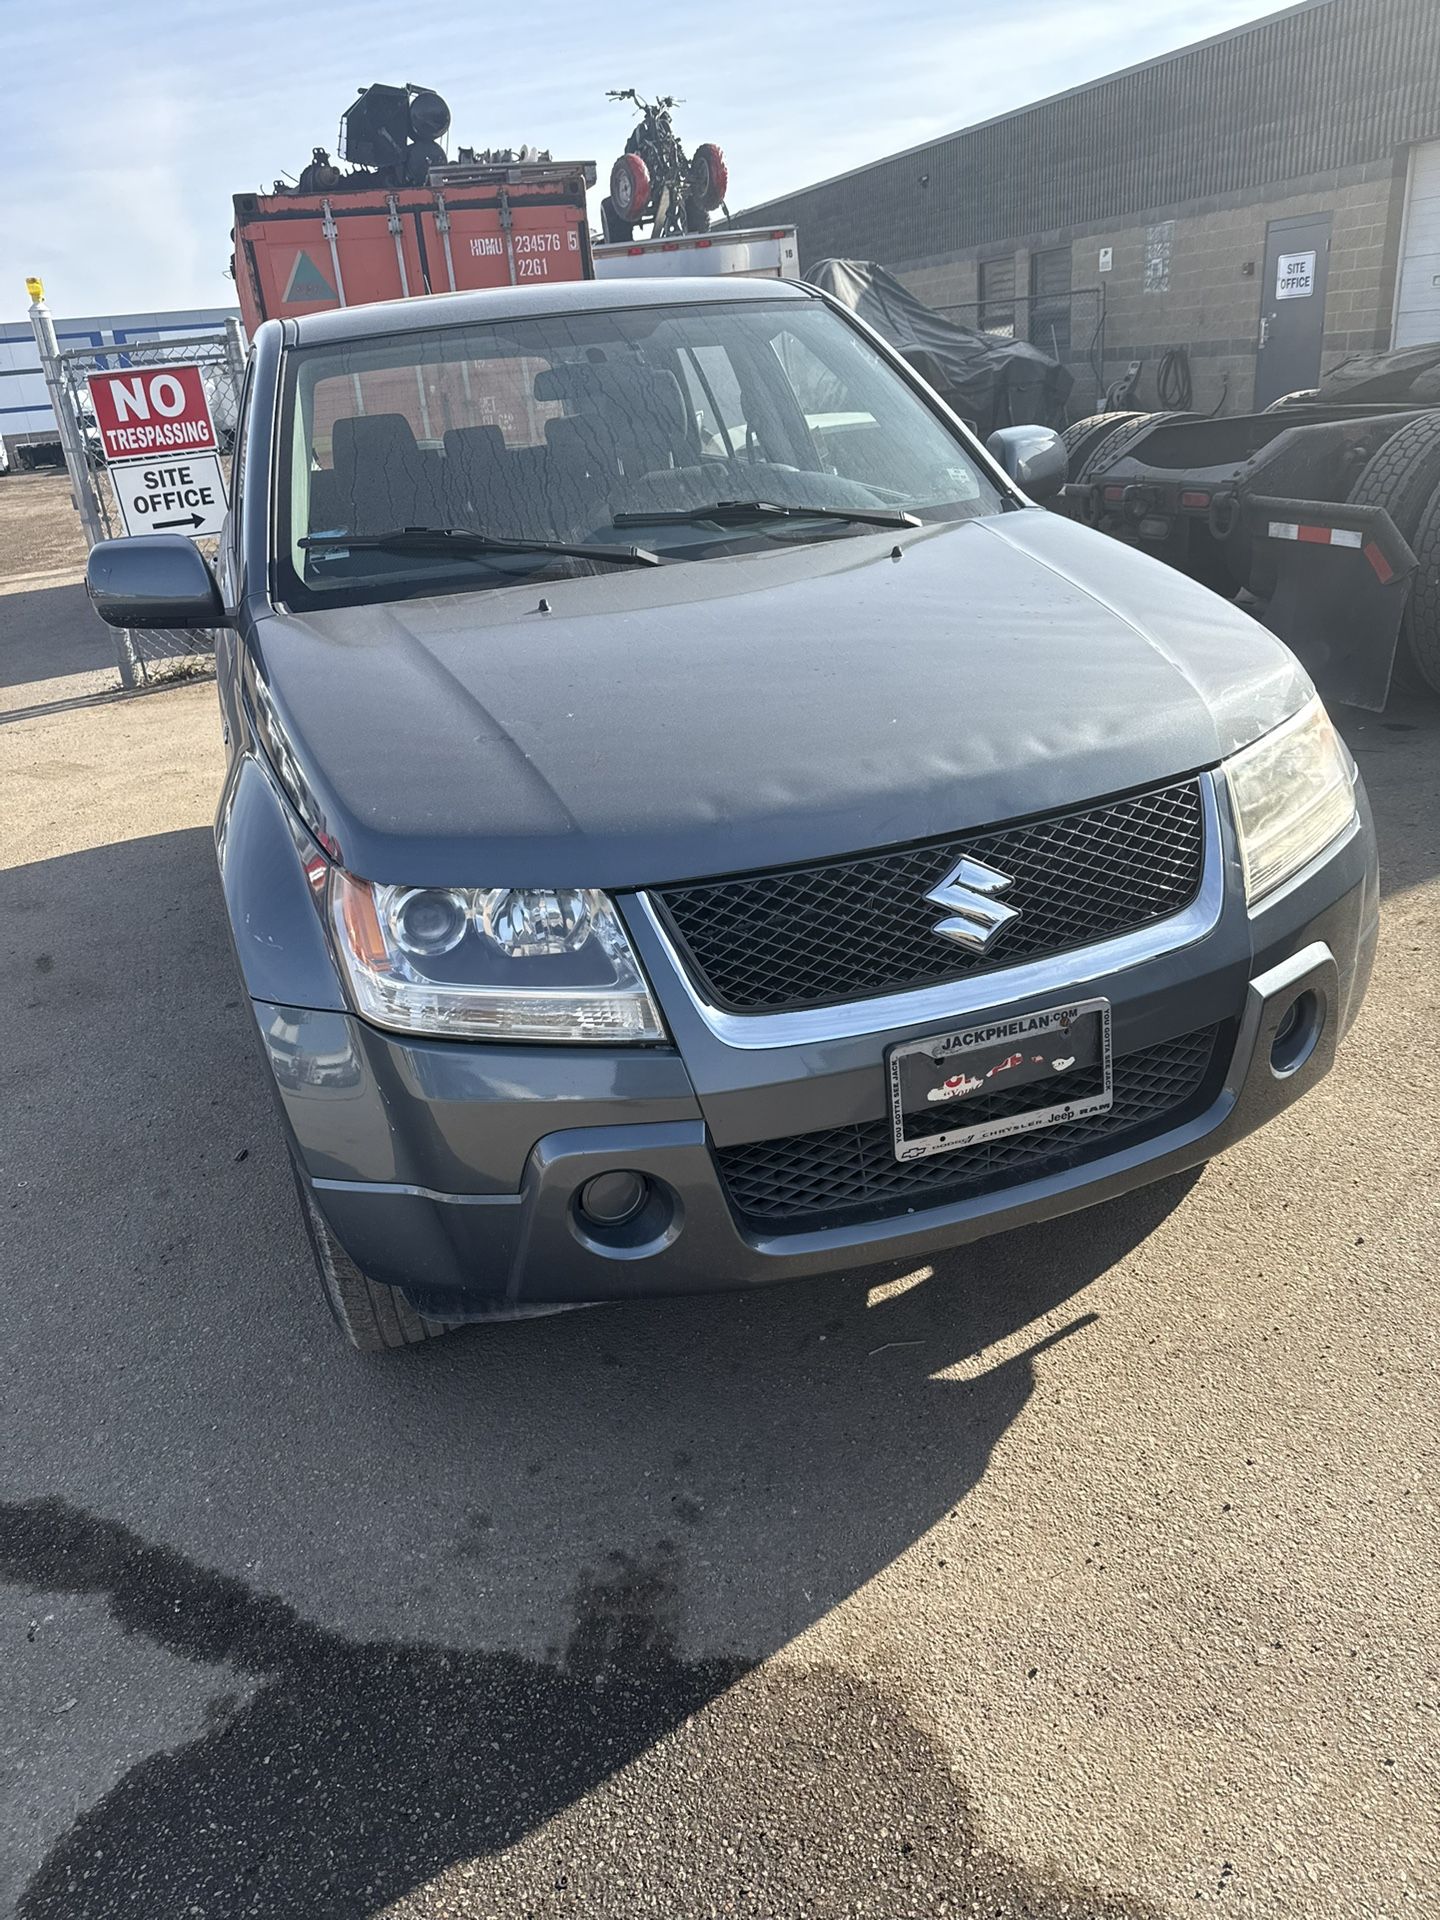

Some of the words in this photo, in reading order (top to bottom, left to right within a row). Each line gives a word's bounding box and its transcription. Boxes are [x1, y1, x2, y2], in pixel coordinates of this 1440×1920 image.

[469, 238, 503, 256] HDMU
[515, 233, 561, 253] 234576
[568, 232, 578, 250] 5
[518, 258, 548, 276] 22G1
[1287, 261, 1306, 274] SITE
[1280, 276, 1311, 289] OFFICE
[109, 374, 186, 422] NO
[106, 420, 210, 451] TRESPASSING
[143, 466, 193, 489] SITE
[133, 487, 215, 514] OFFICE
[942, 1009, 1078, 1049] JACKPHELAN.COM
[982, 1120, 1042, 1138] CHRYSLER
[1048, 1110, 1075, 1124] Jeep
[1079, 1103, 1111, 1115] RAM
